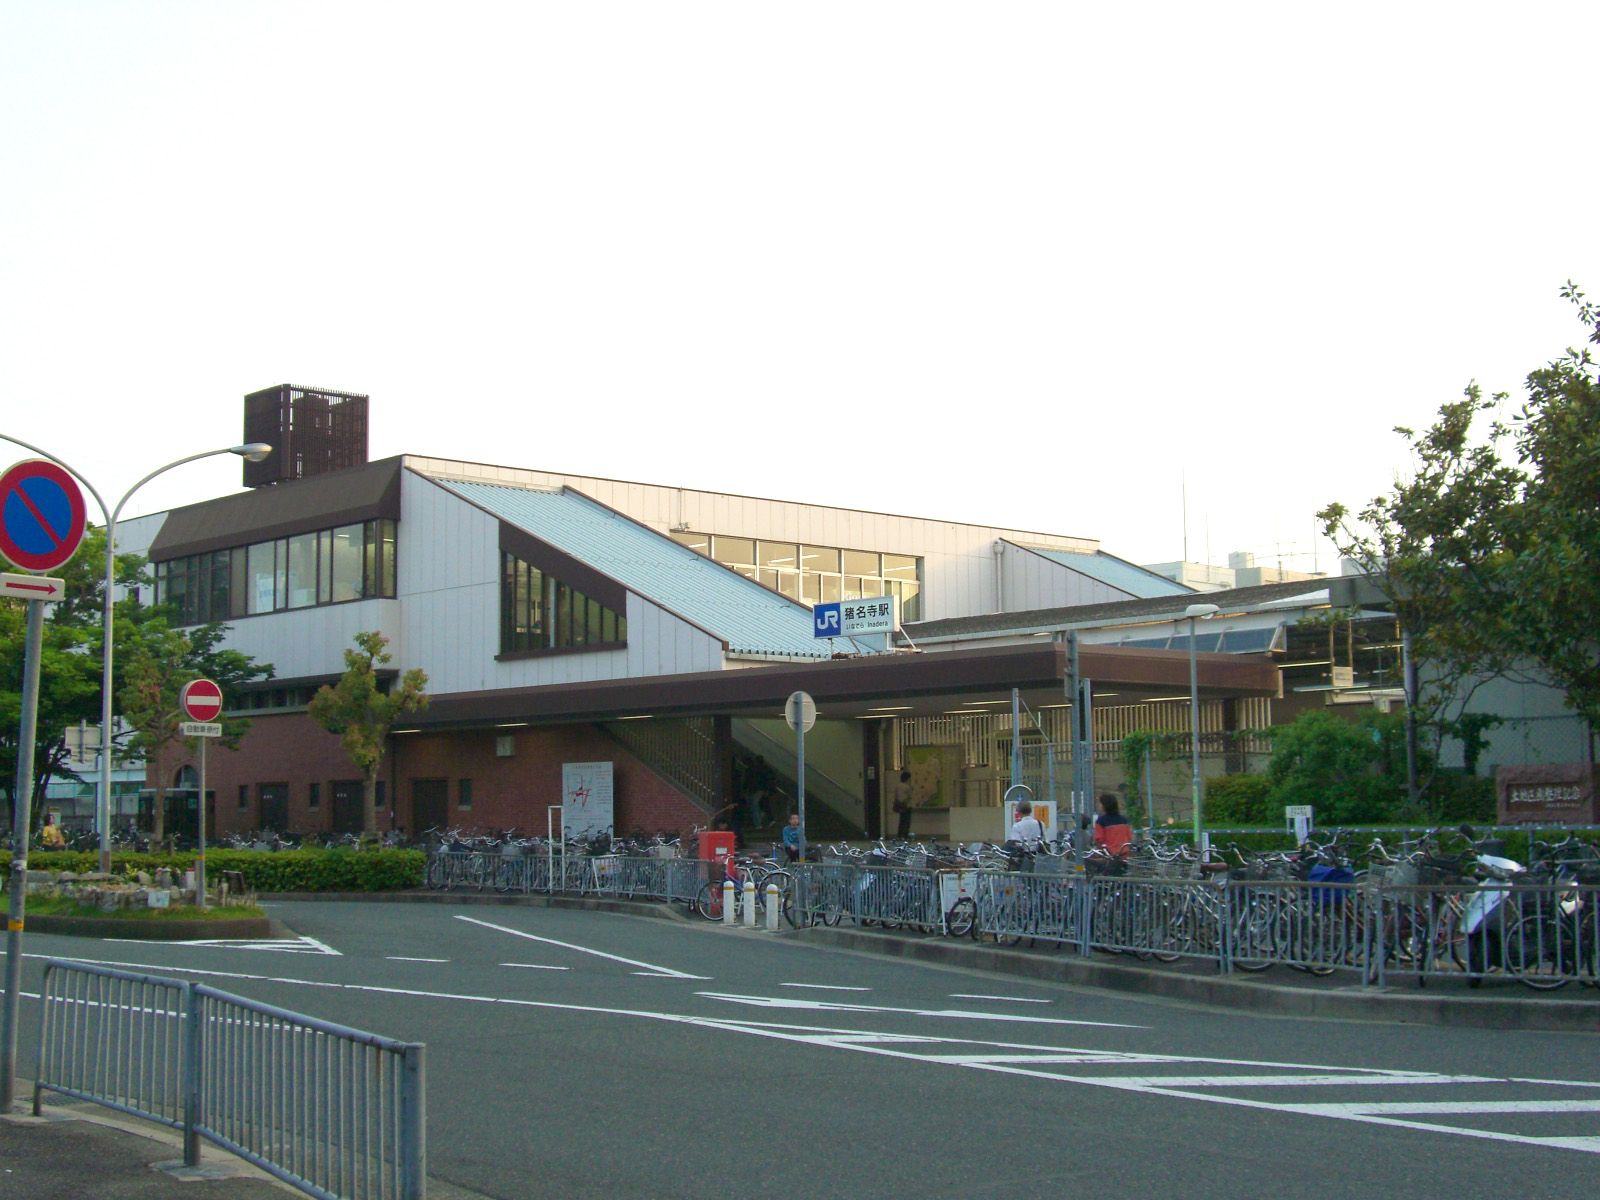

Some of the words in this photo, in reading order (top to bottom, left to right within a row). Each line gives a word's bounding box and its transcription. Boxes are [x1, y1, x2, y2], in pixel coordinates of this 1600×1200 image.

[816, 610, 839, 629] JR
[844, 602, 890, 621] 猪名寺駅
[867, 620, 889, 628] Inadera
